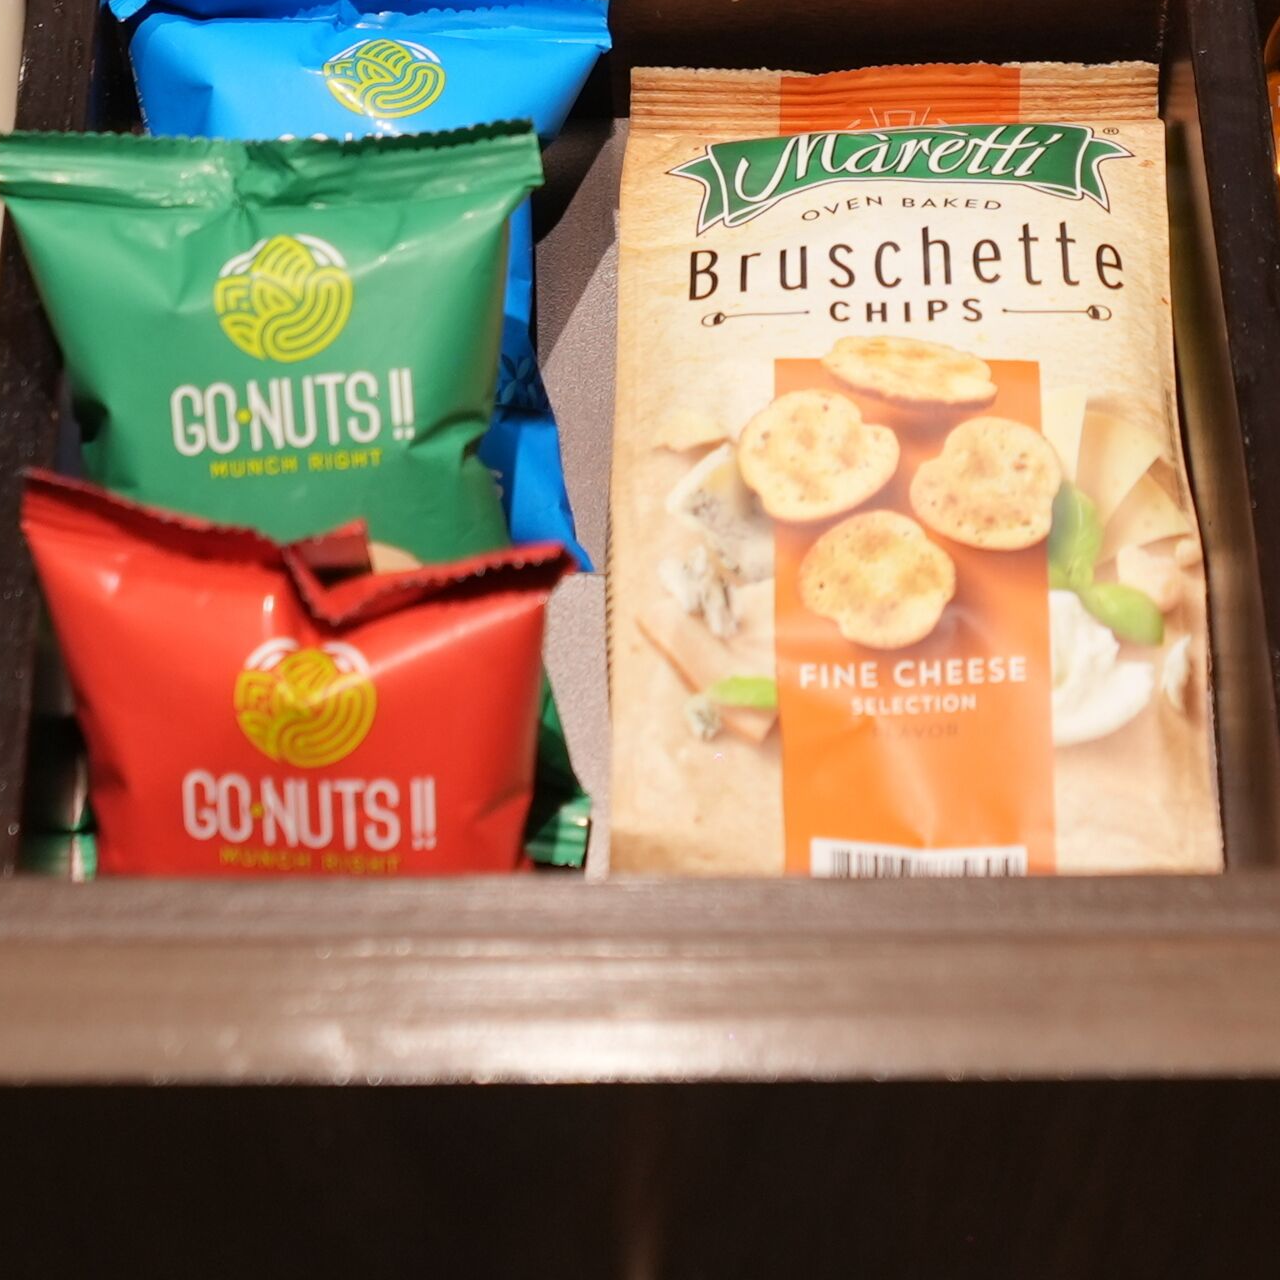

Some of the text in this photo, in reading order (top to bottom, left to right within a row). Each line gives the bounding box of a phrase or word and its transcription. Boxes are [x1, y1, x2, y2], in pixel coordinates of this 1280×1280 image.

[733, 126, 1064, 203] Maretti
[801, 195, 1002, 222] OVEN BAKED
[687, 221, 1125, 301] Bruschette
[829, 297, 983, 323] CHIPS
[209, 448, 383, 479] MUNCH RIGHT
[799, 656, 1028, 689] FINE CHEESE
[851, 694, 977, 717] SELECTION
[219, 846, 401, 874] MUNCH RIGHT
